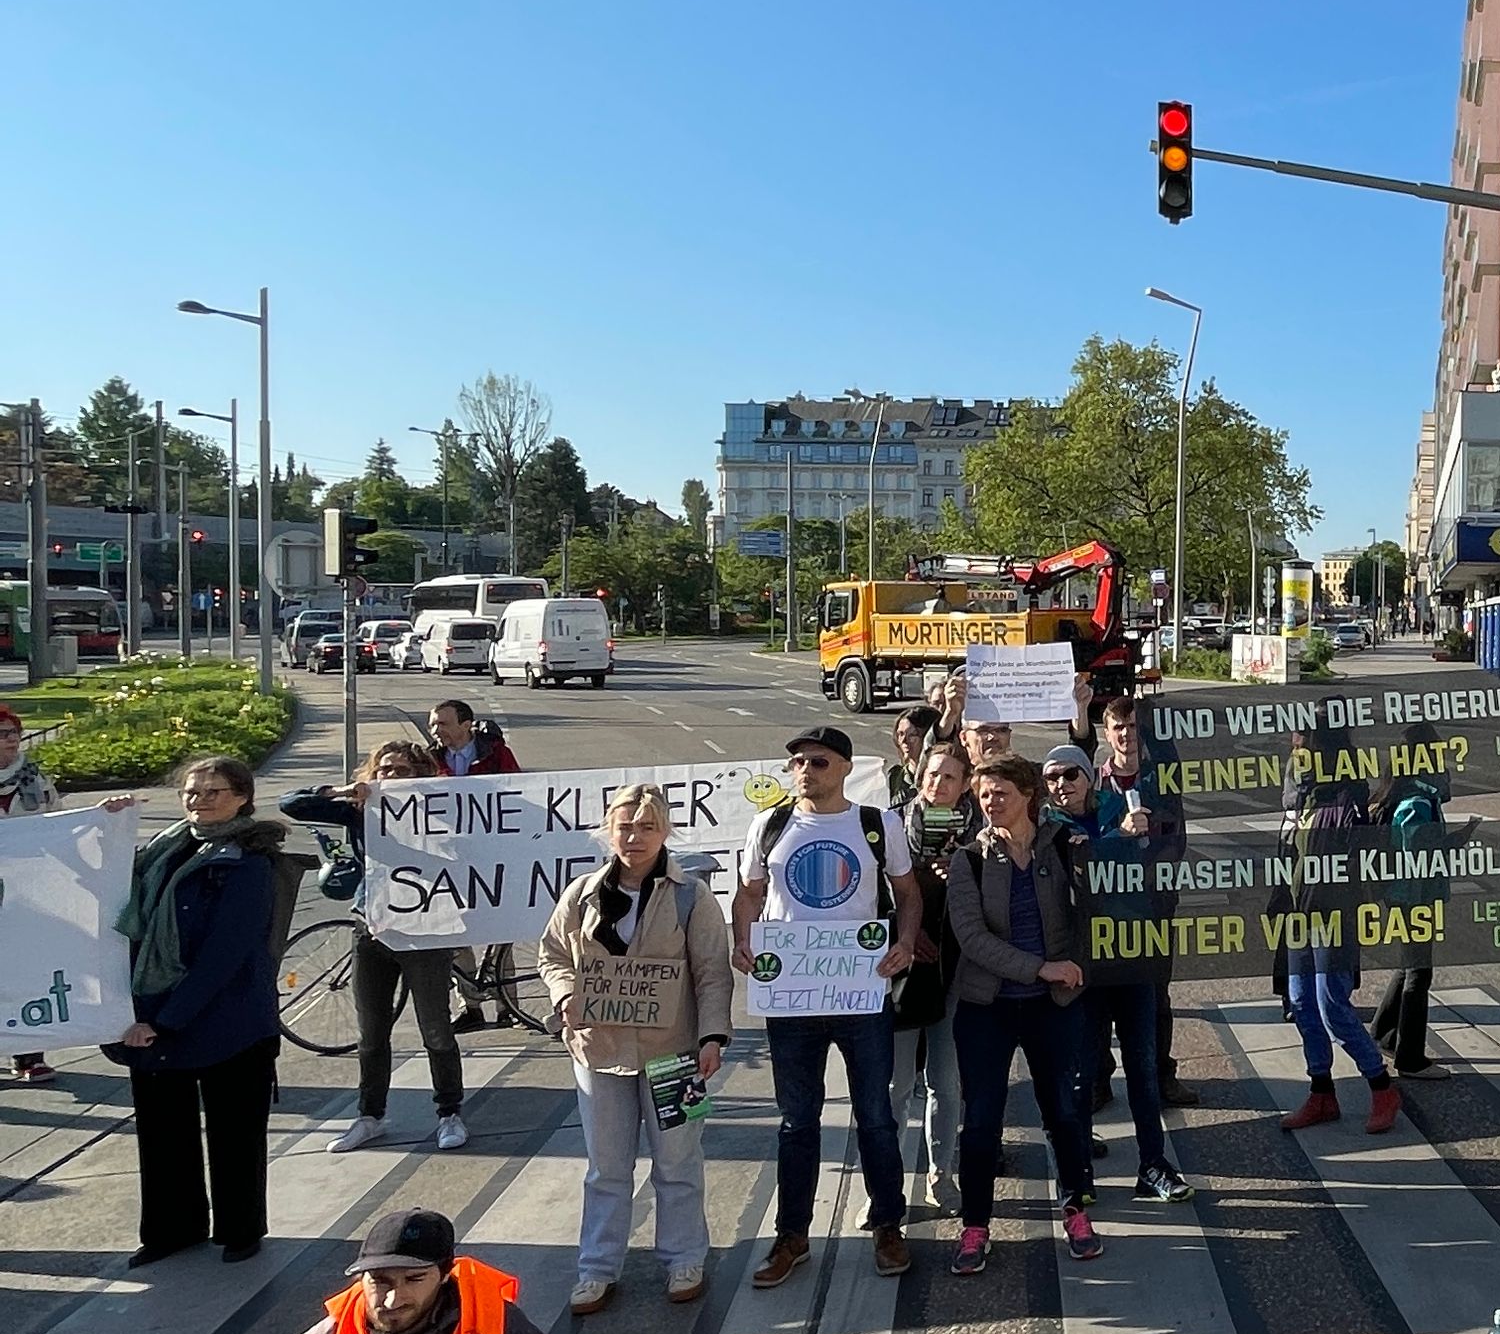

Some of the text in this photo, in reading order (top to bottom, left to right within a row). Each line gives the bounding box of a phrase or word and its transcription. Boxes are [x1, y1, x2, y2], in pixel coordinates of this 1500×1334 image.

[379, 791, 522, 837] MEINE
[387, 862, 505, 914] SAN
[619, 981, 658, 997] EURE
[582, 997, 660, 1023] KINDER
